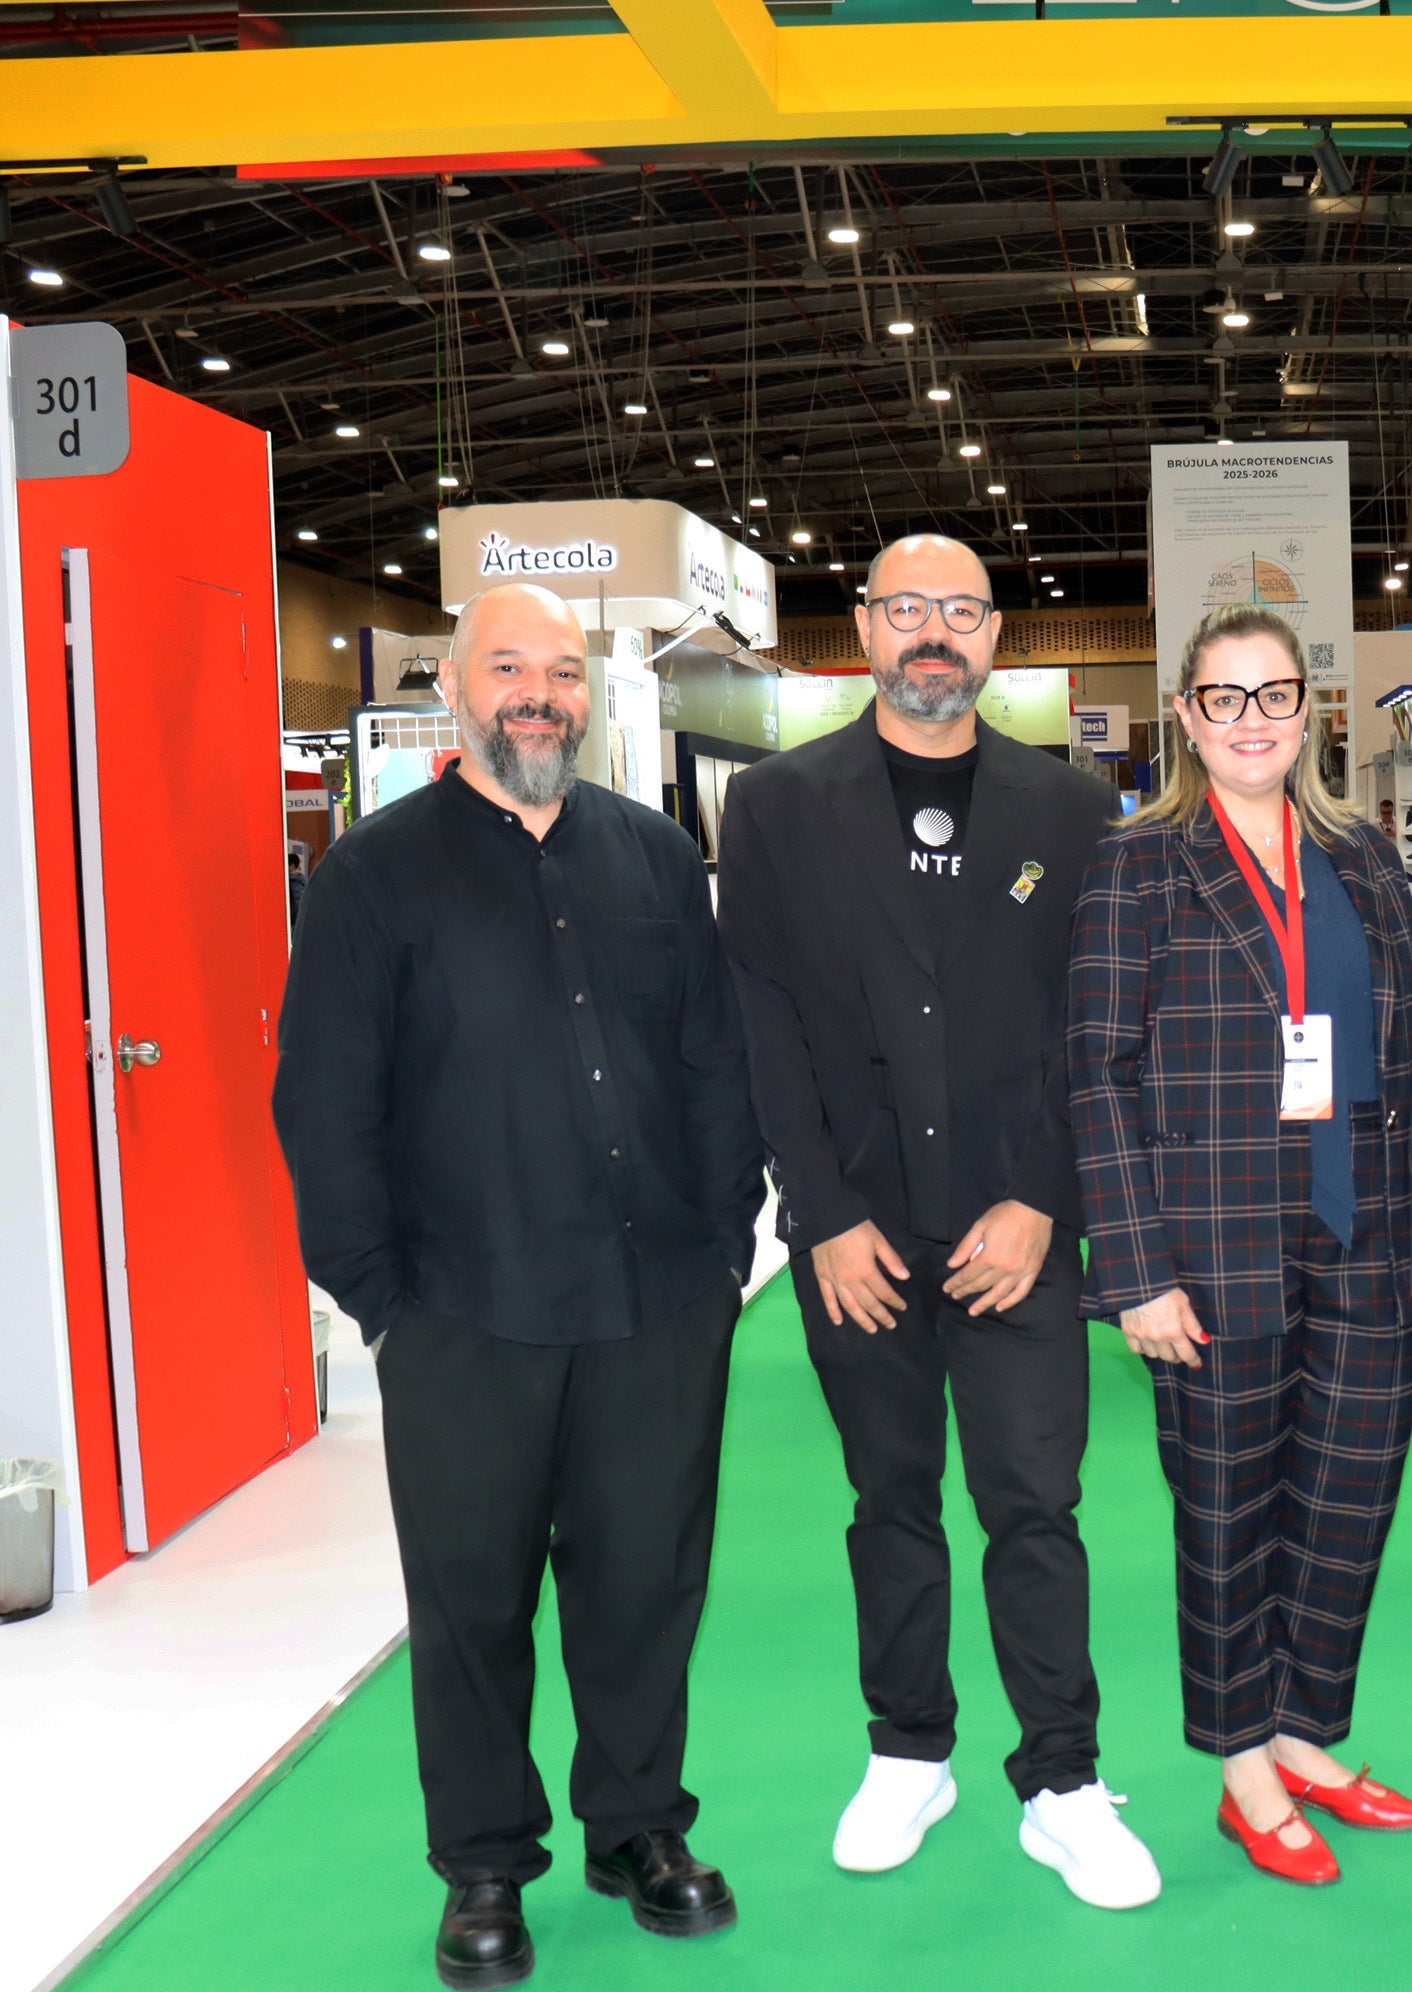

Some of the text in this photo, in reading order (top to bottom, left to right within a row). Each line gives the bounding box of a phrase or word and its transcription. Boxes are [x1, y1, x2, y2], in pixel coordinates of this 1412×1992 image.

[36, 376, 97, 415] 301
[58, 418, 81, 458] d
[1167, 455, 1333, 468] BRÚJULA MACROTENDENCIAS
[1223, 469, 1278, 480] 2025-2026
[483, 541, 613, 573] Artecola
[1082, 721, 1106, 733] tech
